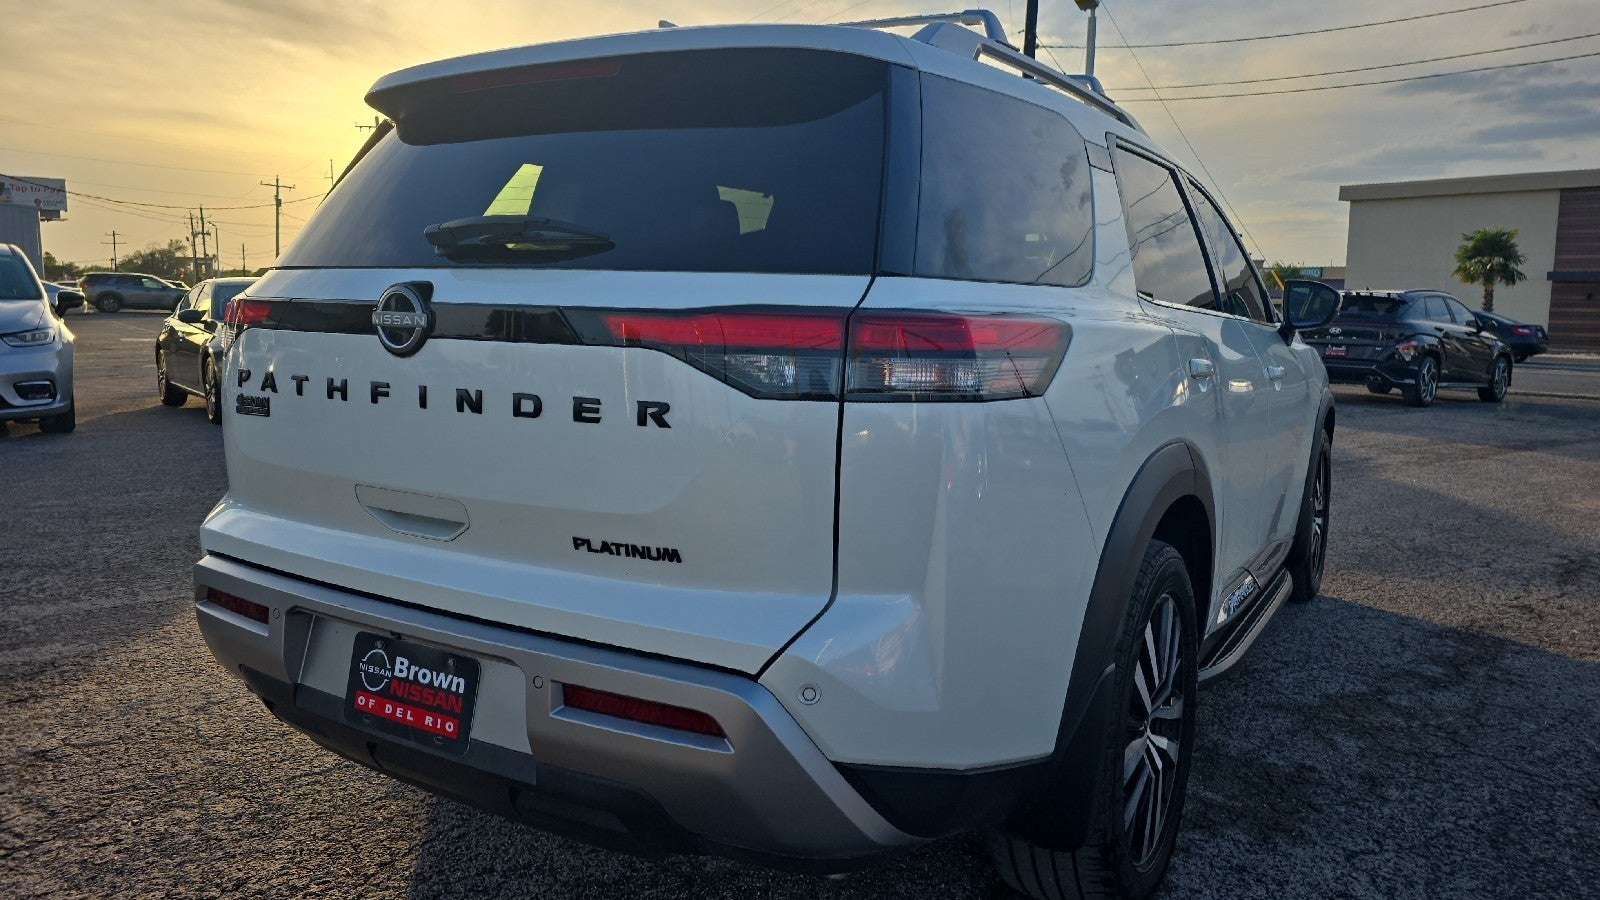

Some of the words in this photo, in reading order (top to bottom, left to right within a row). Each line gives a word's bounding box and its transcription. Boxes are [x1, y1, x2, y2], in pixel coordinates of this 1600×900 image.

[10, 184, 27, 193] Tap
[372, 314, 425, 325] NISSAN
[237, 368, 672, 429] PATHFINDER
[572, 536, 682, 563] PLATINUM
[360, 662, 392, 677] NISSAN
[394, 655, 465, 694] Brown
[390, 678, 463, 714] NISSAN
[357, 695, 376, 709] OF
[385, 703, 414, 721] DEL
[424, 716, 454, 732] RIO
